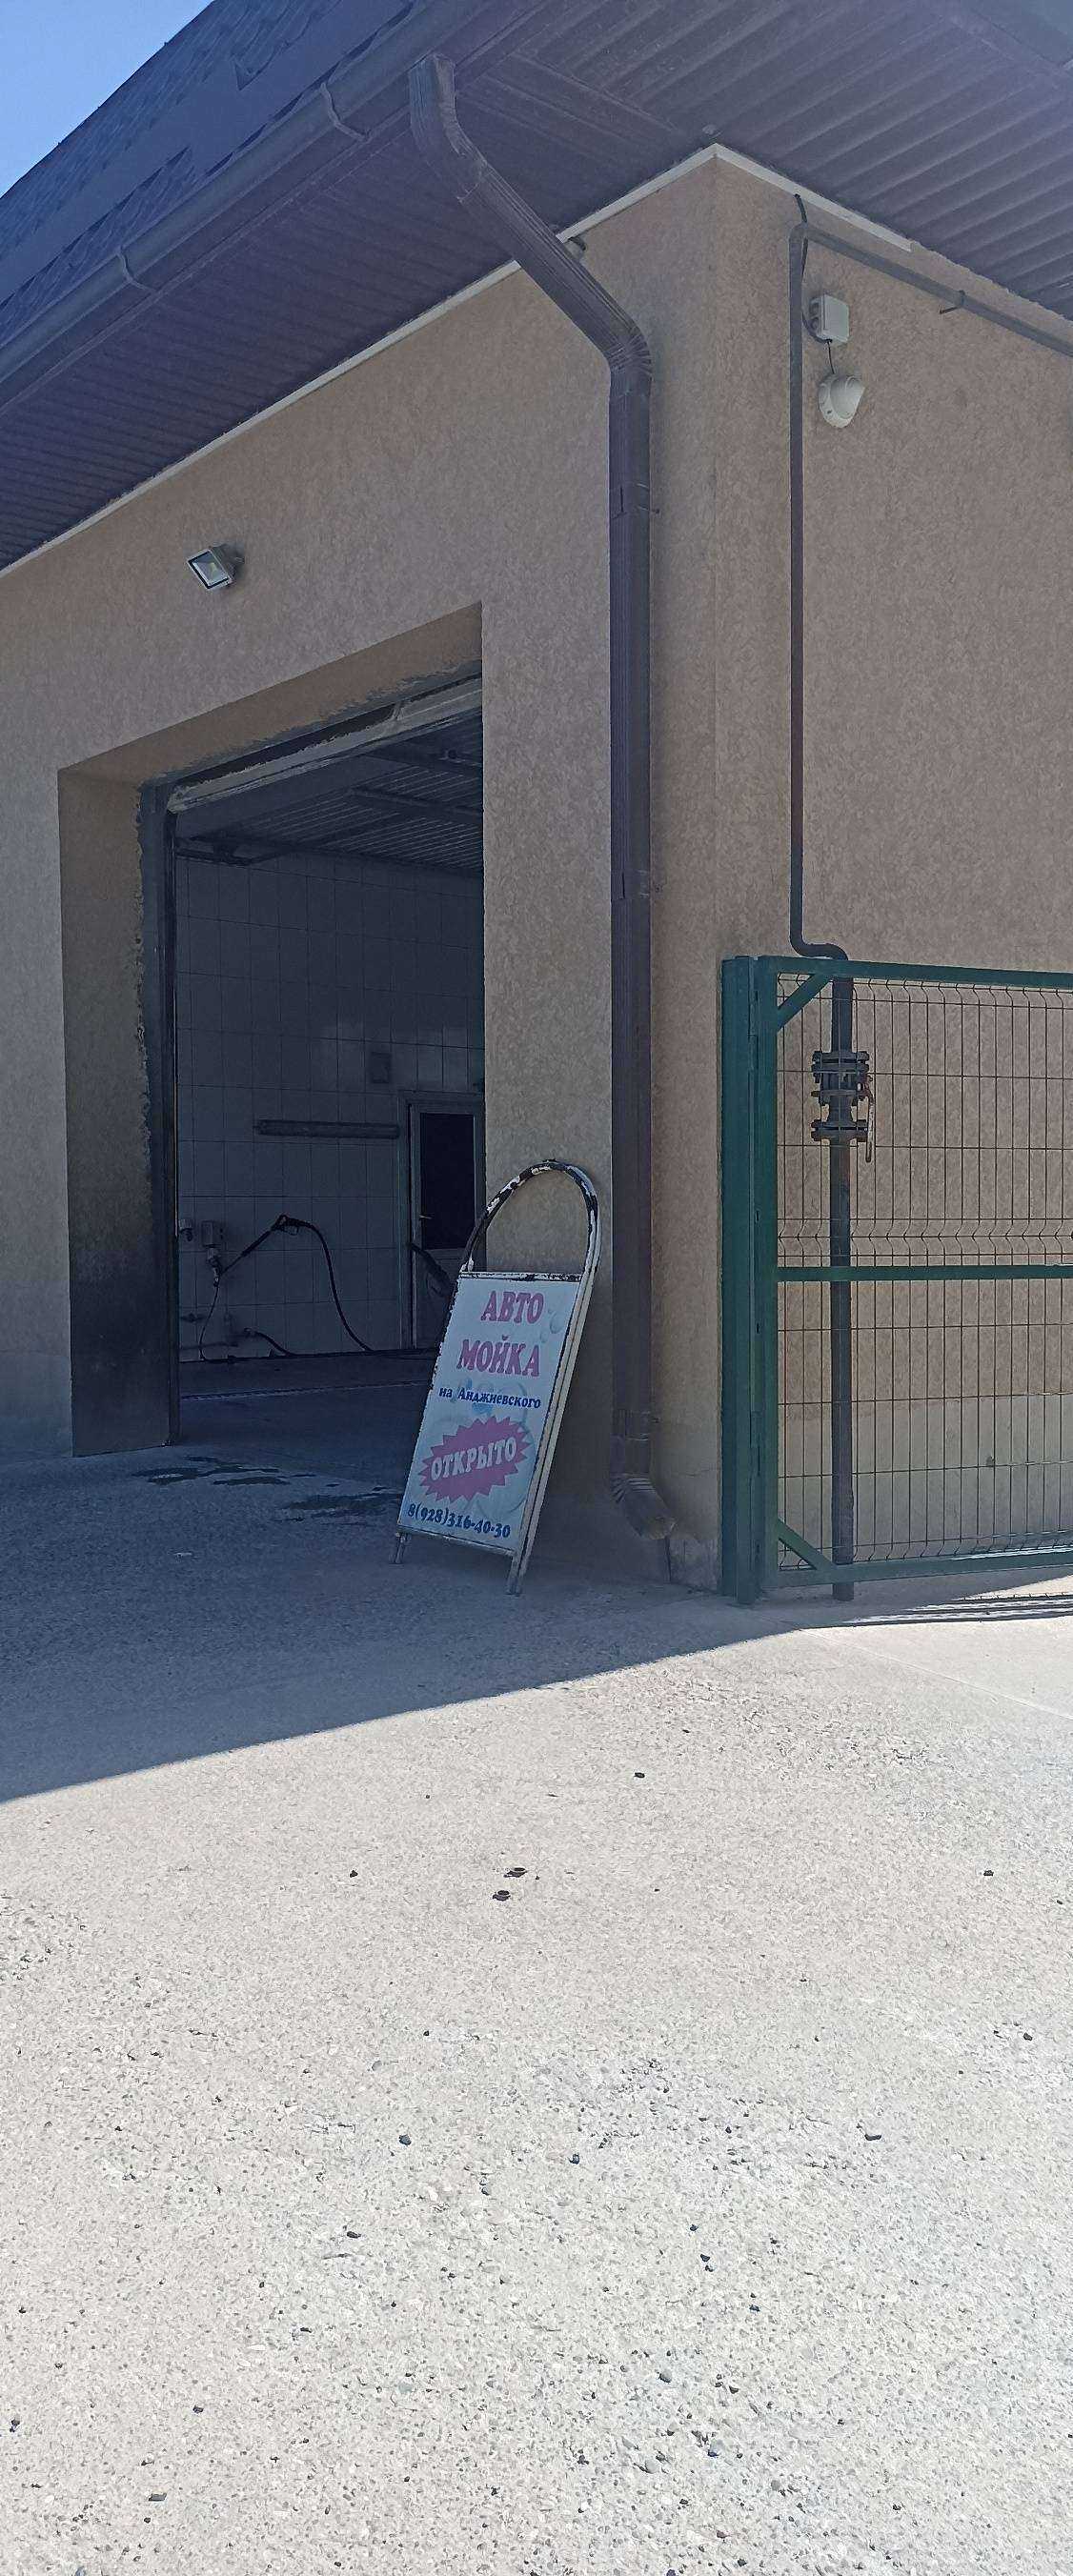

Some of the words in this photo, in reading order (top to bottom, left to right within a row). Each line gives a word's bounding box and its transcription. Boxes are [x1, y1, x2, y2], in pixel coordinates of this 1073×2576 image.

[480, 1291, 544, 1324] АВТО
[456, 1335, 539, 1378] МОЙКА
[438, 1387, 453, 1398] на
[458, 1388, 541, 1408] Анджиевского
[431, 1437, 516, 1480] ОТКРЫТО
[408, 1502, 511, 1539] 8(928)316-40-30
